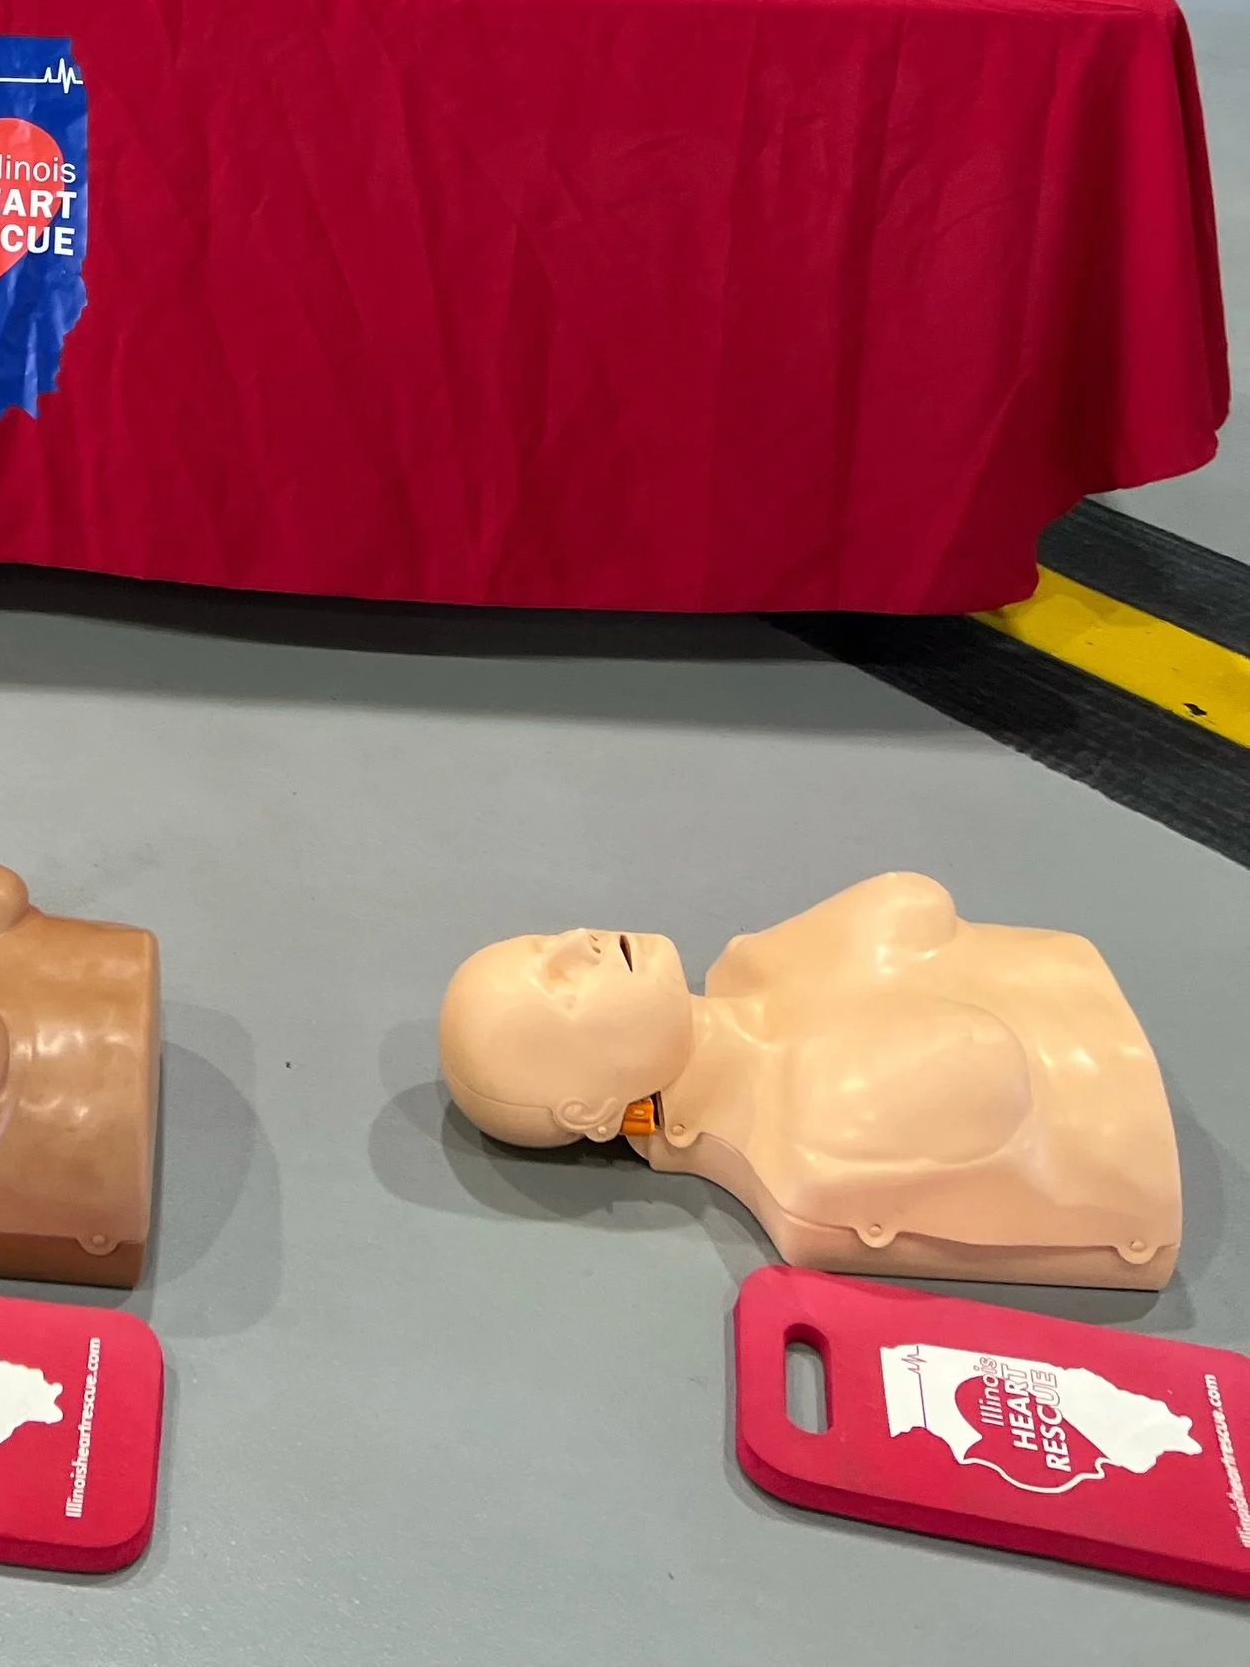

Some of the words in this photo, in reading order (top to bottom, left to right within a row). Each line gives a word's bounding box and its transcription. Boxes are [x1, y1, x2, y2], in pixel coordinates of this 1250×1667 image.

[974, 1357, 1004, 1426] Illinois
[1001, 1363, 1038, 1451] HEART
[1030, 1368, 1072, 1472] RESCUE
